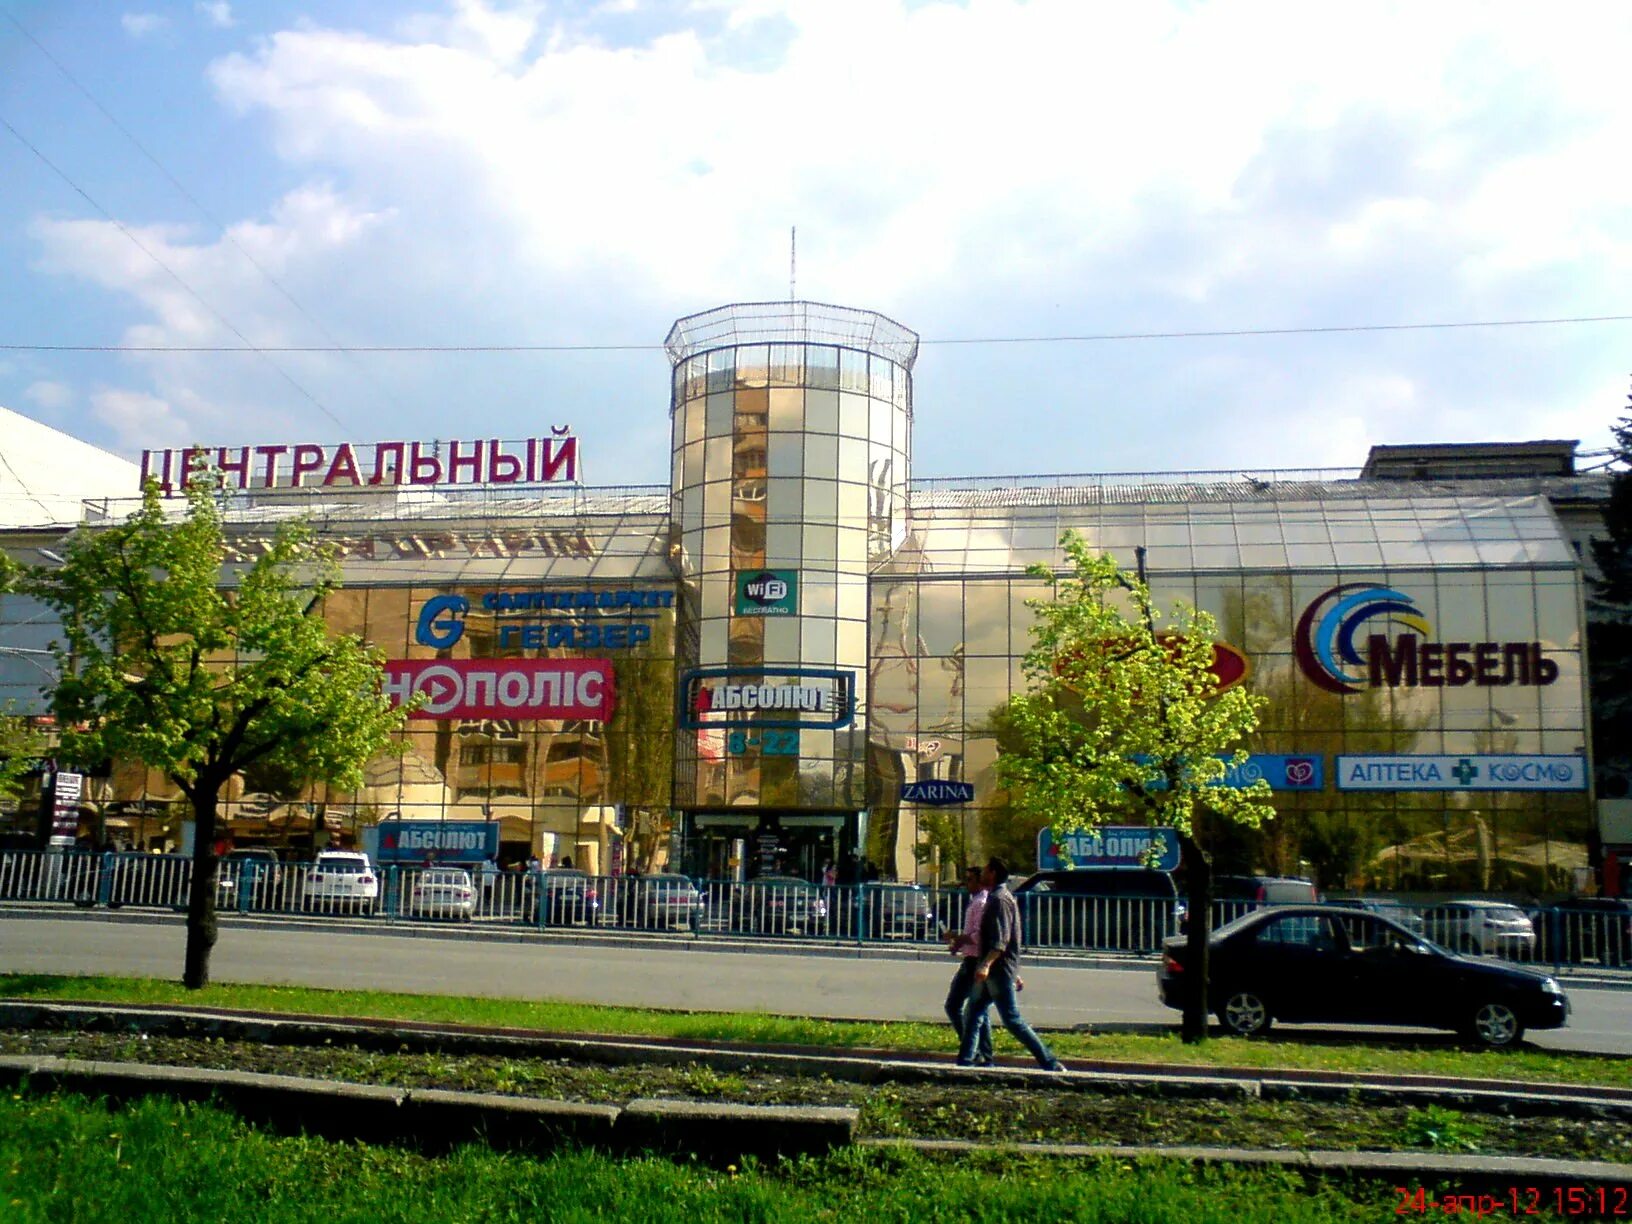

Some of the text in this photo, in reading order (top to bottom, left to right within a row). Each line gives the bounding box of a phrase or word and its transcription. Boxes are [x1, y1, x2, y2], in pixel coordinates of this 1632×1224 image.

[139, 424, 579, 499] ЦЕНТРАЛЬНЫЙ
[482, 590, 674, 610] САНТЕХМАРКЕТ
[500, 623, 651, 649] ГЕЙЗЕР
[364, 665, 605, 714] НОПОЛІС
[710, 684, 831, 710] АБСОЛЮТ
[1350, 762, 1573, 782] АПТЕКА КОСМО
[903, 784, 970, 800] ZARINA
[397, 830, 487, 850] АБСОЛЮТ
[1064, 837, 1164, 857] АБСОЛЮ
